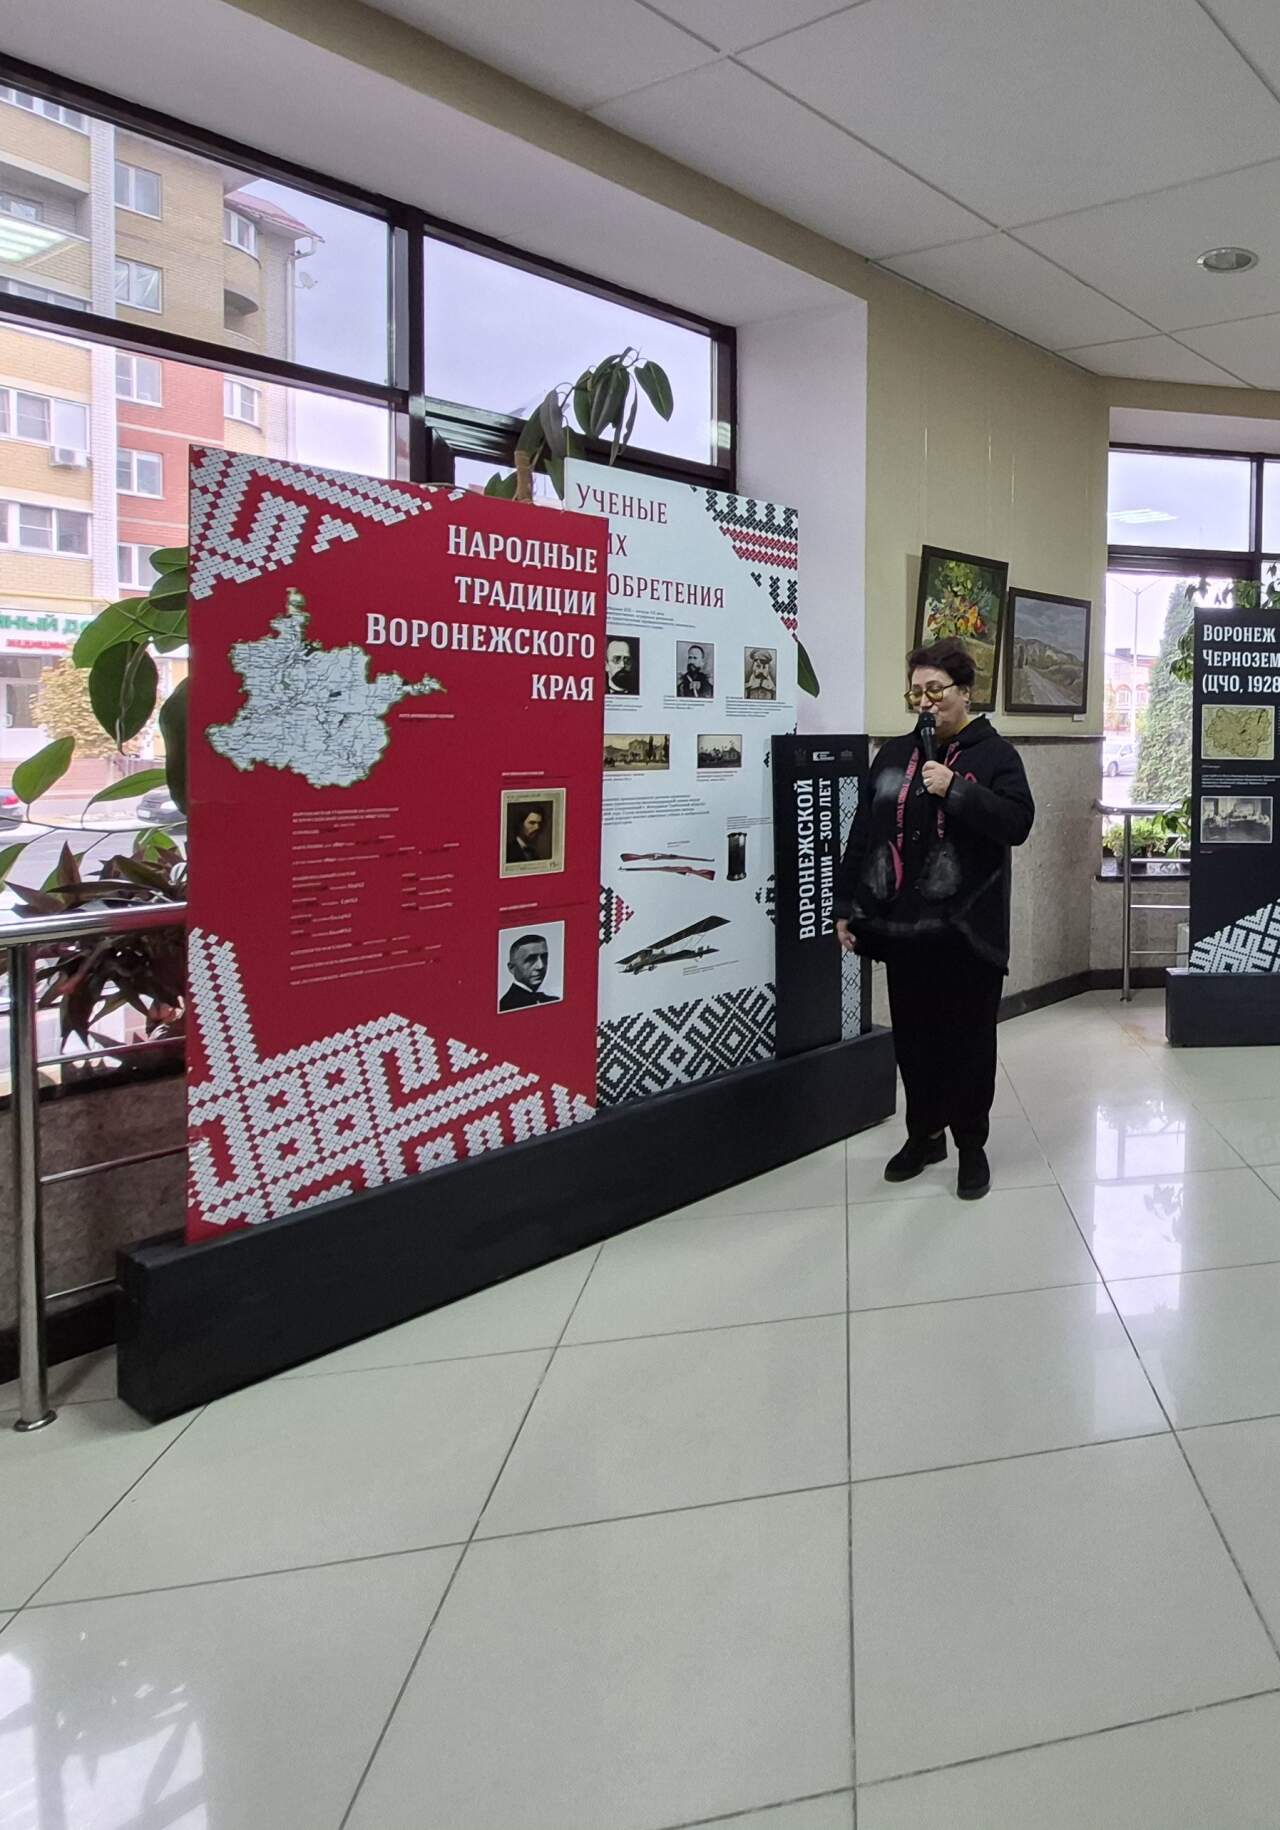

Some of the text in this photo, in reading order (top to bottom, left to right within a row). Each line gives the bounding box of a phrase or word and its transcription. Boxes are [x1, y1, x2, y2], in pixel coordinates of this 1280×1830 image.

[576, 482, 668, 525] УЧЕНЫЕ
[447, 524, 598, 574] НАРОДНЫЕ
[454, 575, 597, 616] ТРАДИЦИИ
[608, 573, 725, 608] ОБРЕТЕНИЯ
[365, 612, 595, 659] ВОРОНЕЖСКОГО
[1203, 624, 1276, 643] ВОРОНЕЖ
[530, 673, 595, 701] КРАЯ
[1202, 673, 1244, 694] (ЦЧО,
[819, 778, 832, 807] ЛЕТ
[819, 811, 833, 840] 300
[793, 779, 816, 940] ВОРОНЕЖСКОЙ
[820, 855, 834, 936] ГУБЕРНИИ
